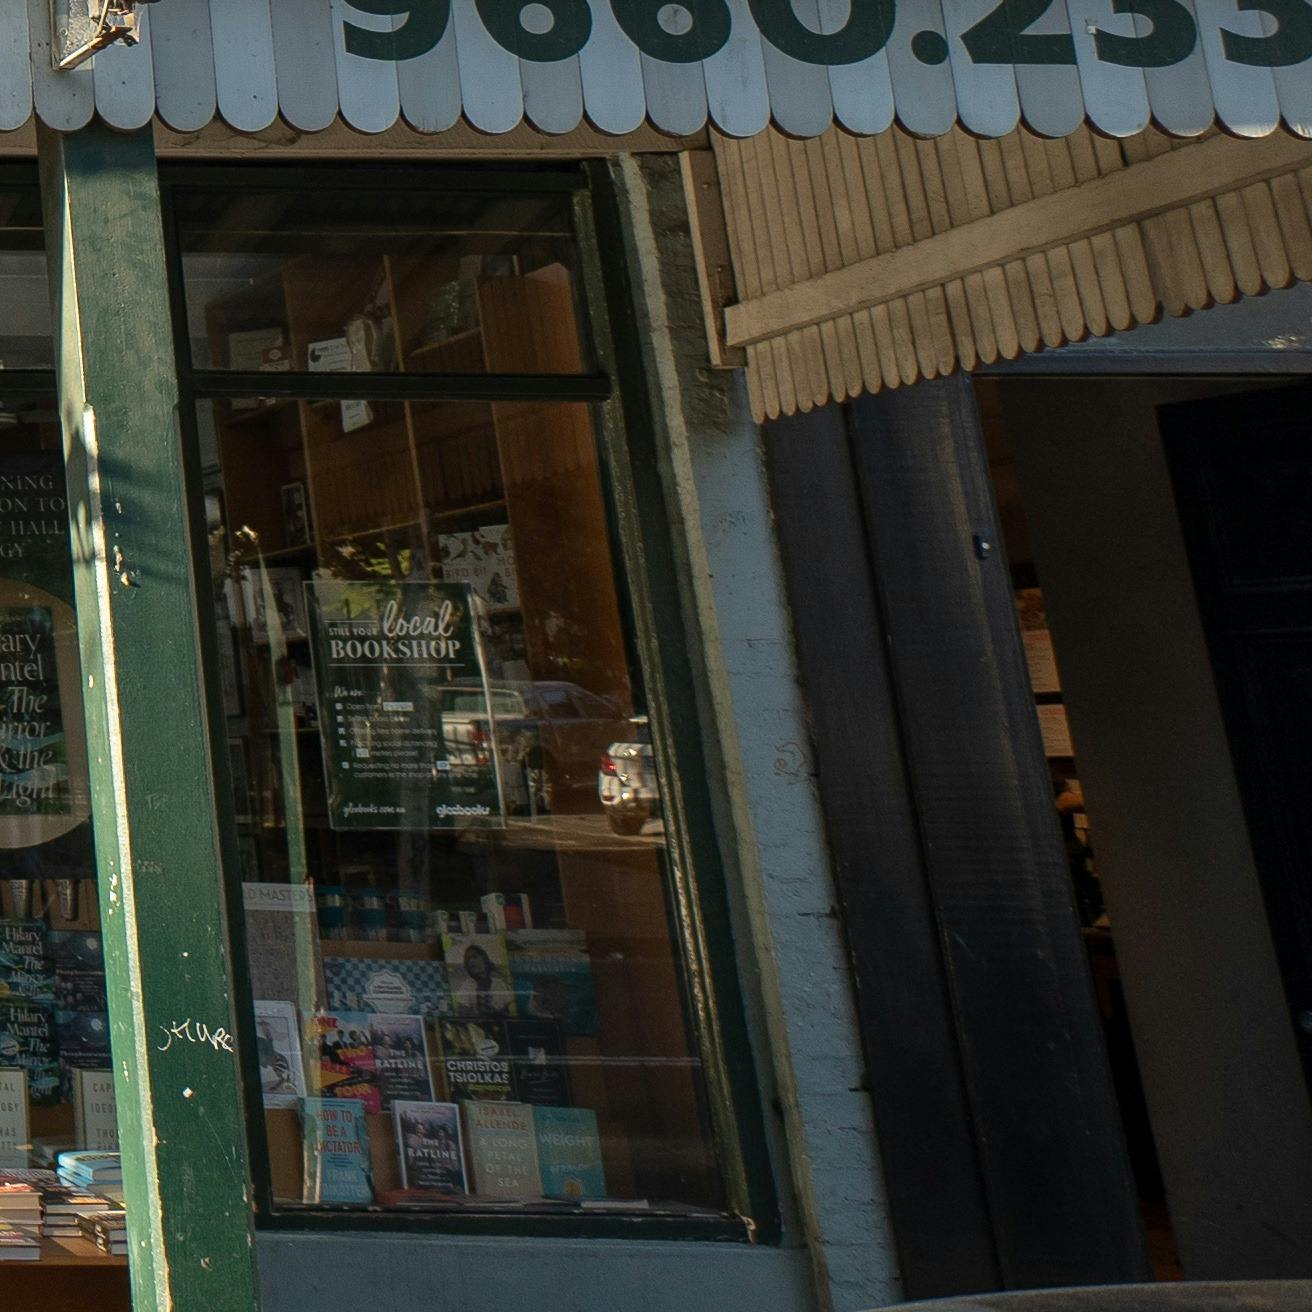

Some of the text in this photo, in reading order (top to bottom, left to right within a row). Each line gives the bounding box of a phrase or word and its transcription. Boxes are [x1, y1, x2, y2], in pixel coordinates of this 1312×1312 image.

[38, 497, 65, 512] TO
[11, 520, 64, 536] HALL
[329, 600, 453, 637] STILL YOUR local
[331, 640, 461, 658] BOOKSHOP
[8, 686, 47, 713] The
[18, 744, 53, 769] the
[5, 926, 42, 941] Hilary
[2, 942, 43, 955] Mantel
[24, 955, 45, 970] The
[9, 1007, 48, 1024] Hilary
[5, 1024, 49, 1037] Mantel
[29, 1038, 50, 1053] The
[376, 1058, 424, 1069] RATLINE
[446, 1060, 510, 1072] CHRISTOS
[448, 1072, 511, 1084] TSIOLKAS
[341, 1109, 353, 1122] TO
[478, 1106, 520, 1118] ISABEL
[327, 1126, 347, 1137] BE A
[476, 1119, 526, 1131] ALLENDE
[422, 1139, 440, 1147] THE
[494, 1139, 527, 1150] LONG
[407, 1149, 457, 1160] RATLINE
[487, 1151, 522, 1162] PETAL
[486, 1163, 528, 1175] OF THE
[497, 1176, 519, 1187] SEA
